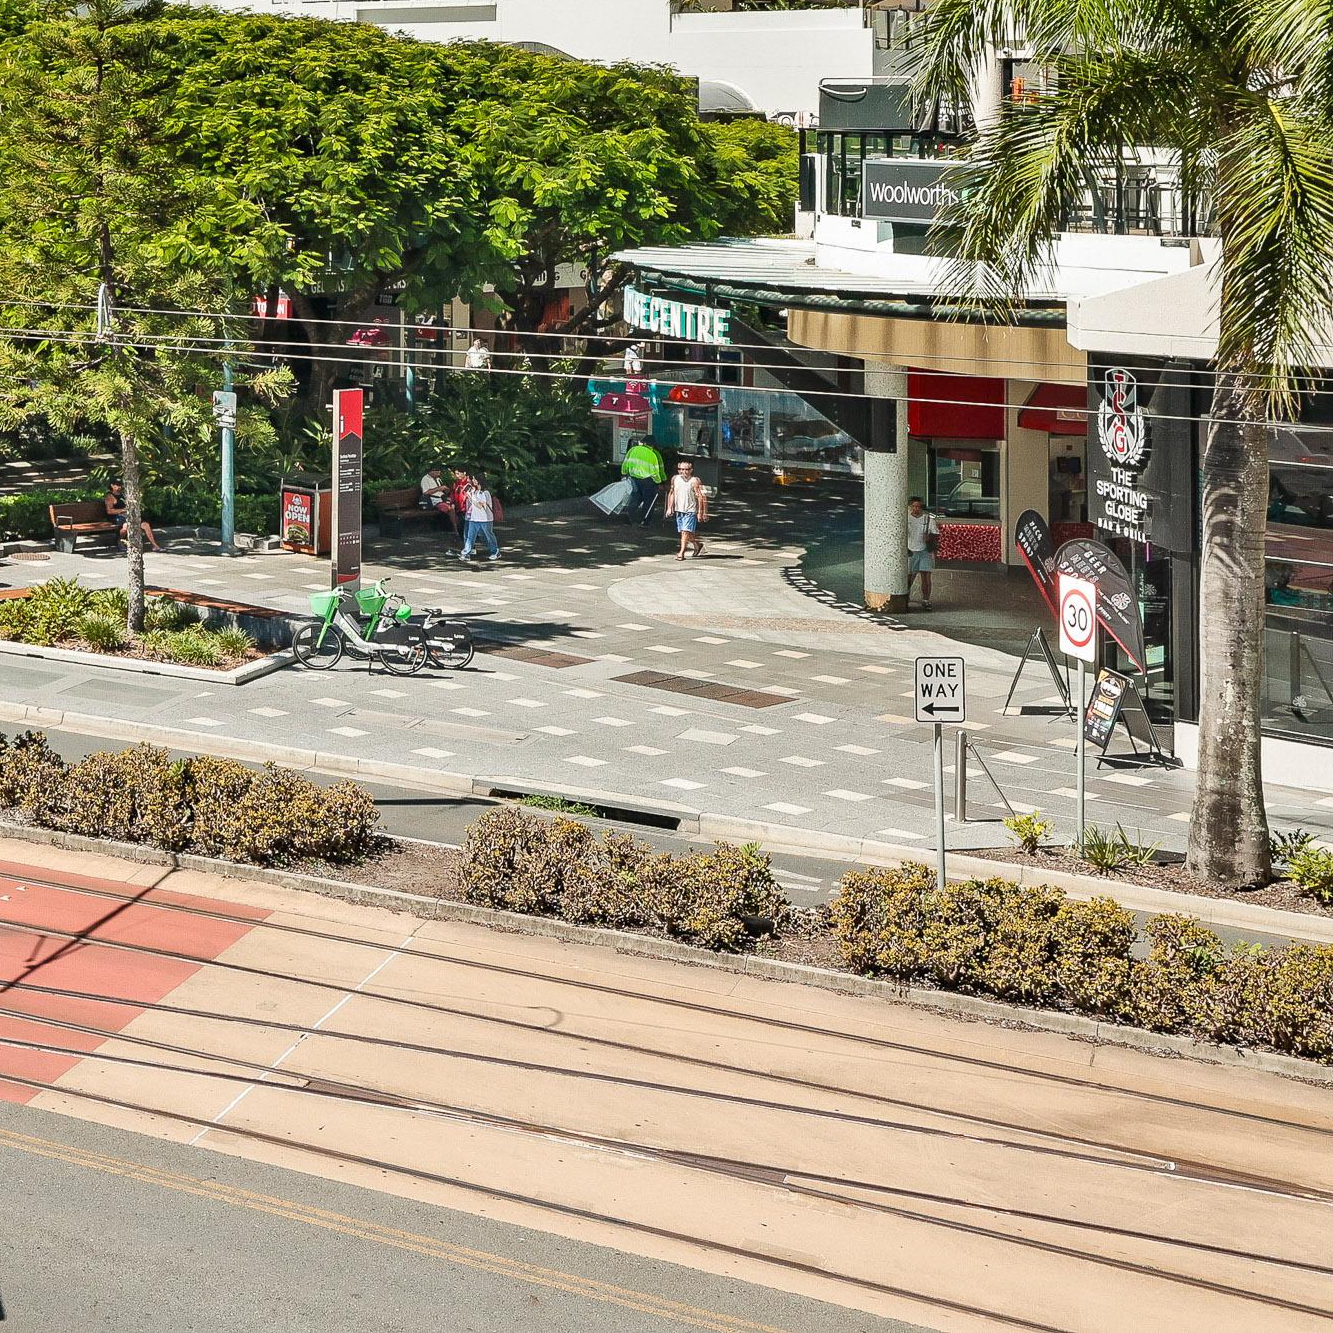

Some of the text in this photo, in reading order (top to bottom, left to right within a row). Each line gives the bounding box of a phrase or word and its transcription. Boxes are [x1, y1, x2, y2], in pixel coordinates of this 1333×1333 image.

[869, 180, 960, 206] Woolworths
[650, 296, 733, 346] CENTRE
[1111, 467, 1134, 487] THE
[1096, 479, 1148, 510] SPORTING
[285, 510, 311, 524] OPEN
[287, 503, 309, 514] NOW
[1105, 500, 1139, 525] GLOBE
[1097, 517, 1114, 532] BAR
[1123, 526, 1147, 544] GRILL
[1069, 553, 1100, 584] MEETS
[1083, 550, 1108, 575] BEER
[1067, 604, 1088, 632] 30
[923, 663, 957, 679] ONE
[920, 683, 959, 698] WAY
